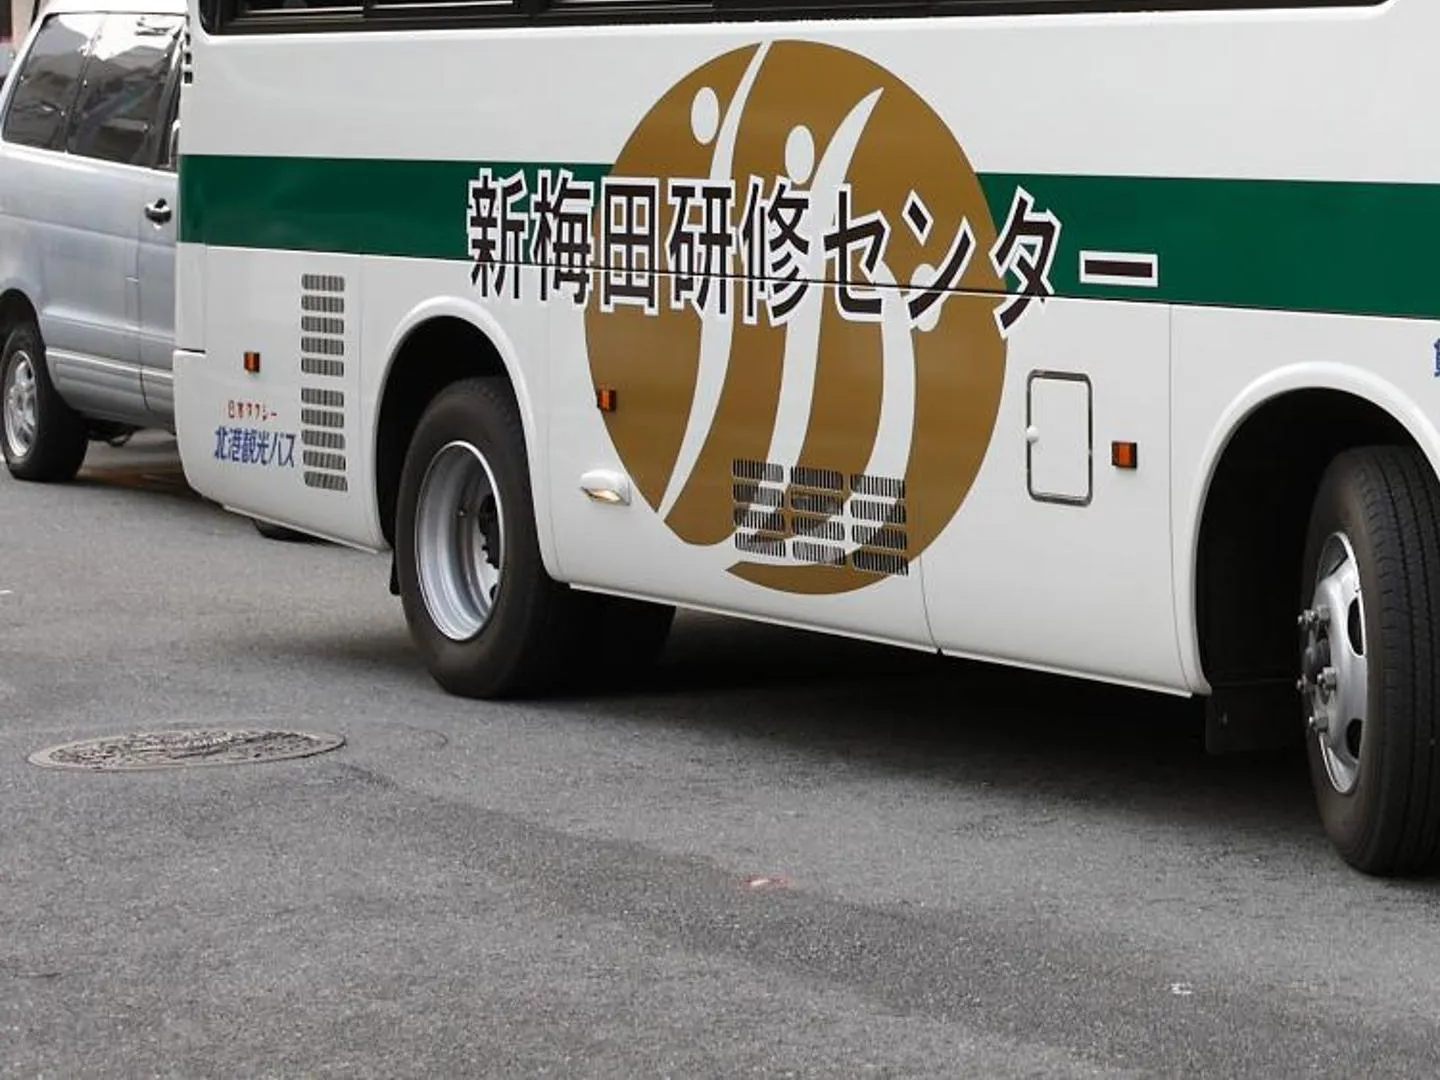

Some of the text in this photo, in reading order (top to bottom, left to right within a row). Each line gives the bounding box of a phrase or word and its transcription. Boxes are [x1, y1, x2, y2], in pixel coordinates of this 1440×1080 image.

[466, 167, 1160, 337] 新梅田研修センター
[214, 426, 296, 468] 北港観光バス
